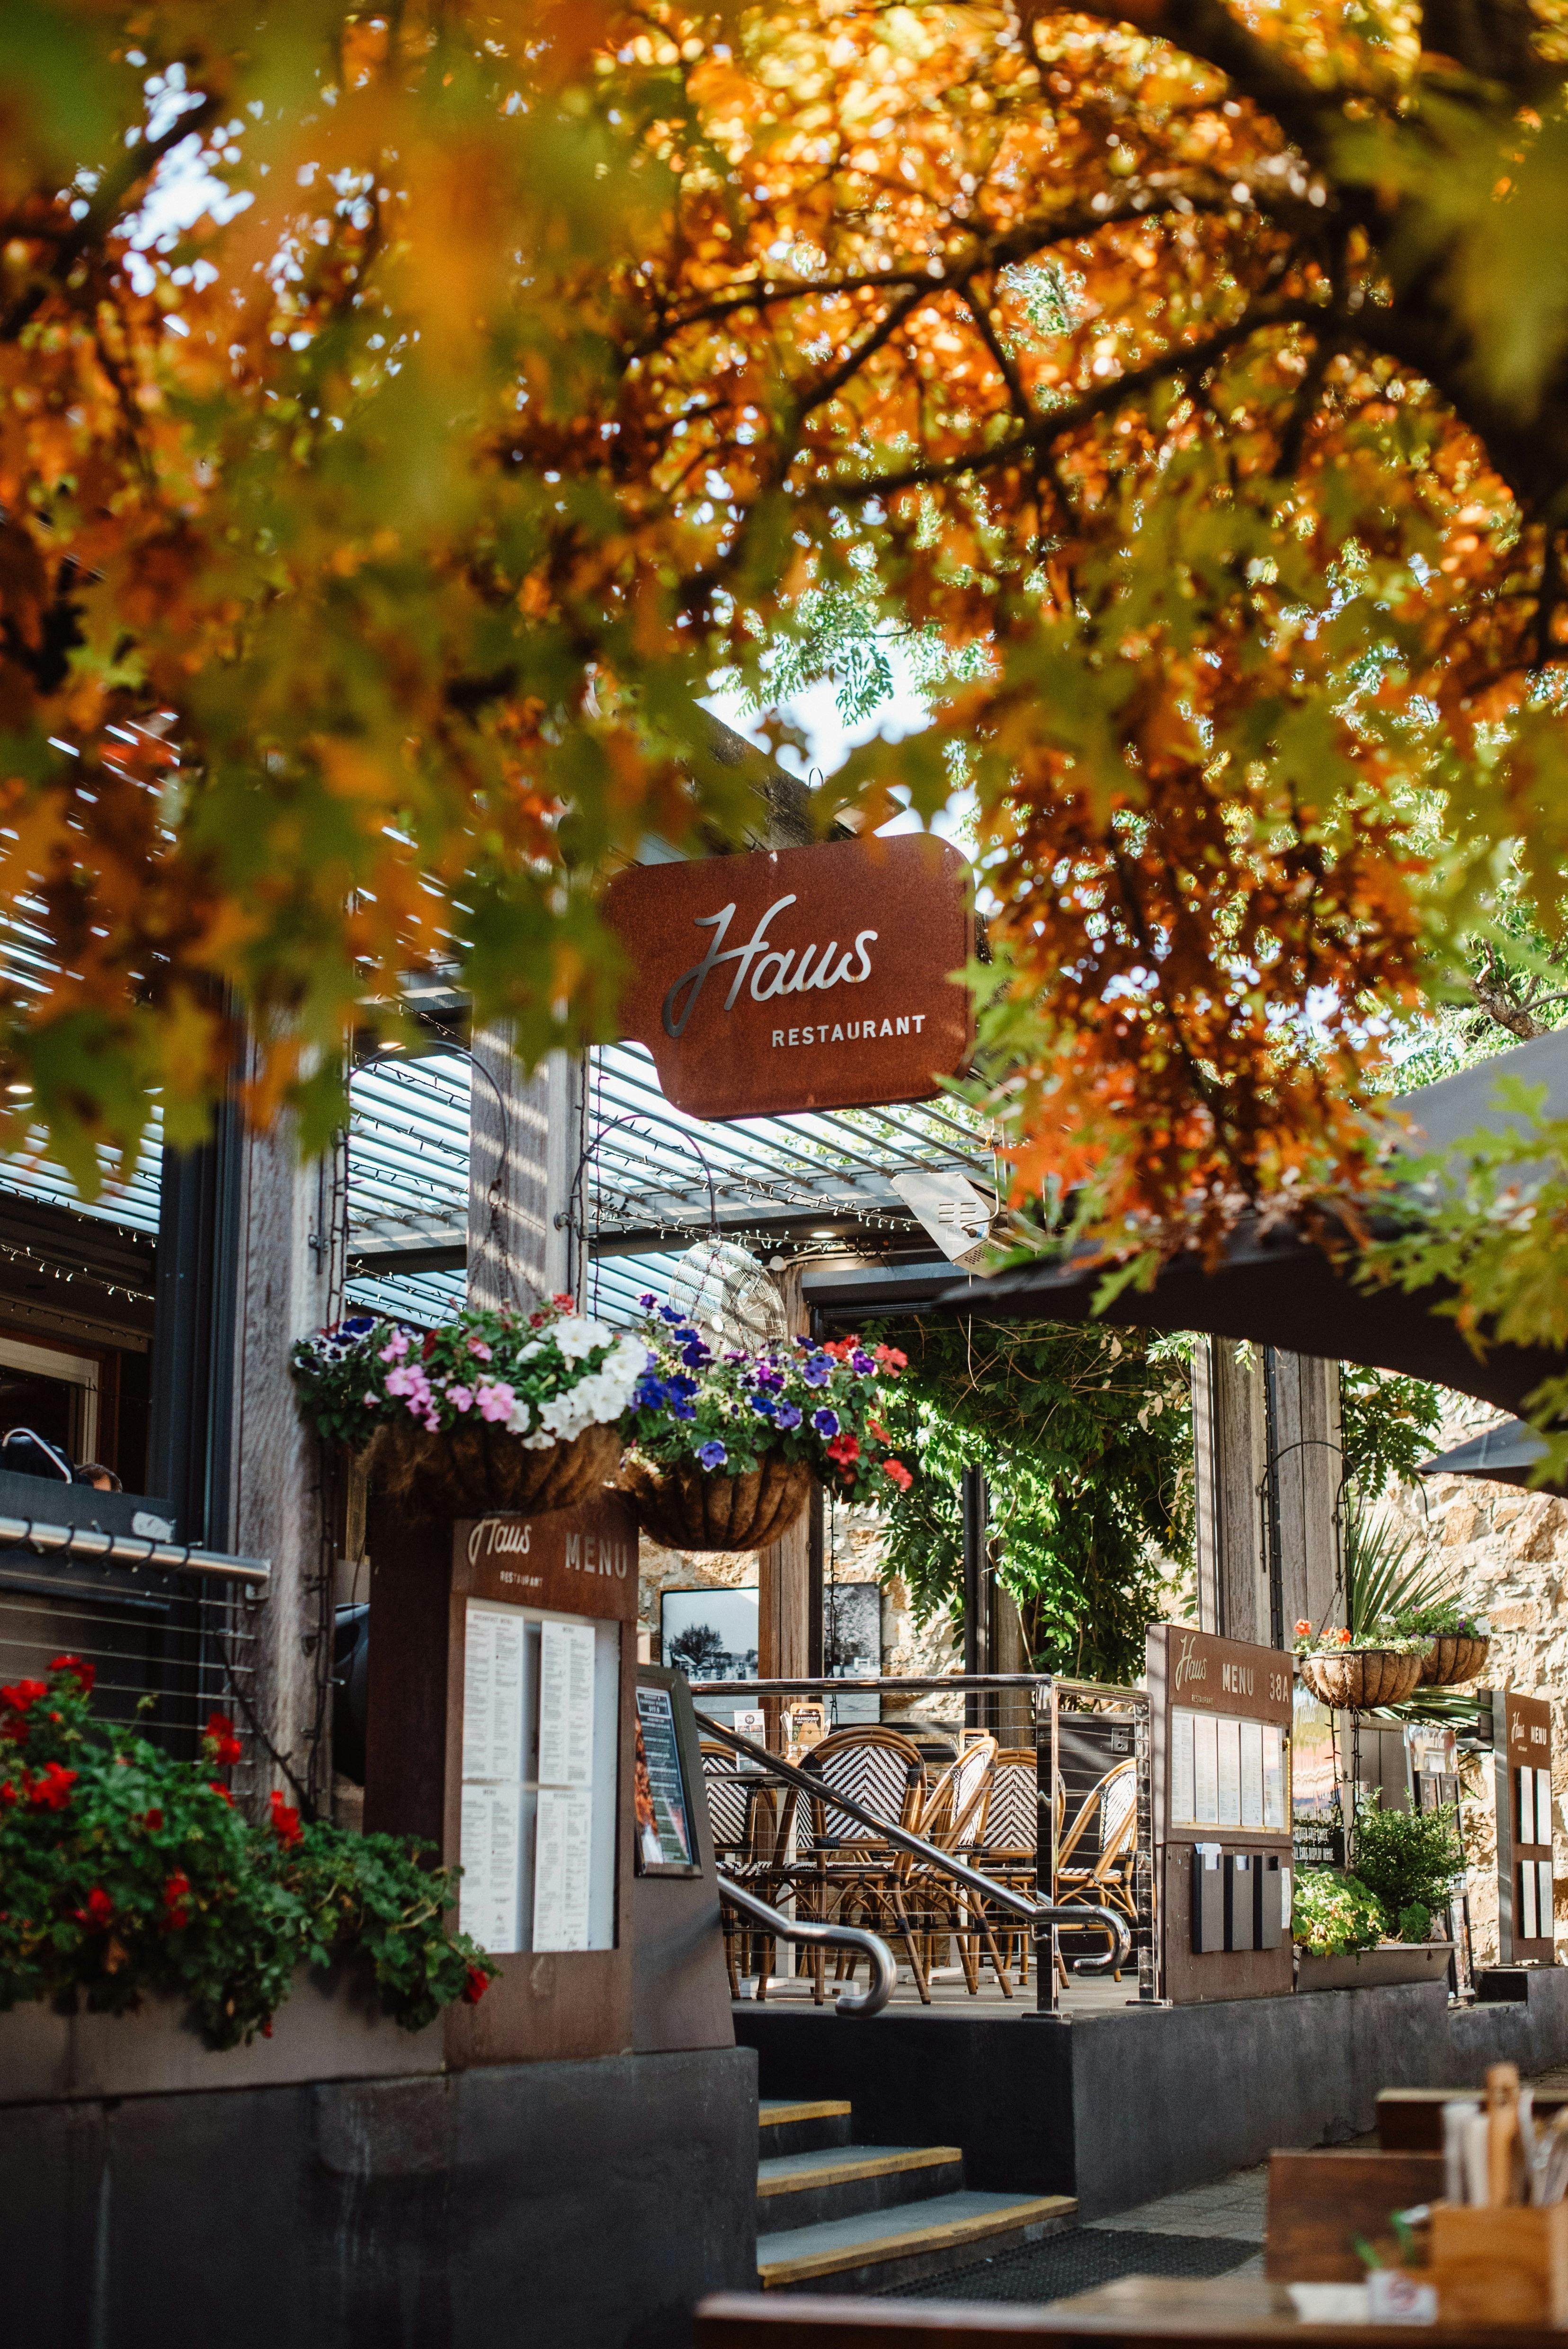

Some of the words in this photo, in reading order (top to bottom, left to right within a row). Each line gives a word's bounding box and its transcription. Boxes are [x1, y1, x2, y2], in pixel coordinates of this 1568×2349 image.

[663, 894, 878, 1037] Haus
[772, 1015, 926, 1047] RESTAURANT
[565, 1532, 628, 1579] MENU
[1175, 1635, 1207, 1691] Haus
[1191, 1694, 1213, 1705] RESTAURANT
[1222, 1663, 1254, 1696] MENU
[1269, 1672, 1289, 1703] 38A
[1511, 1711, 1525, 1744] Haus
[1530, 1725, 1547, 1746] MENU
